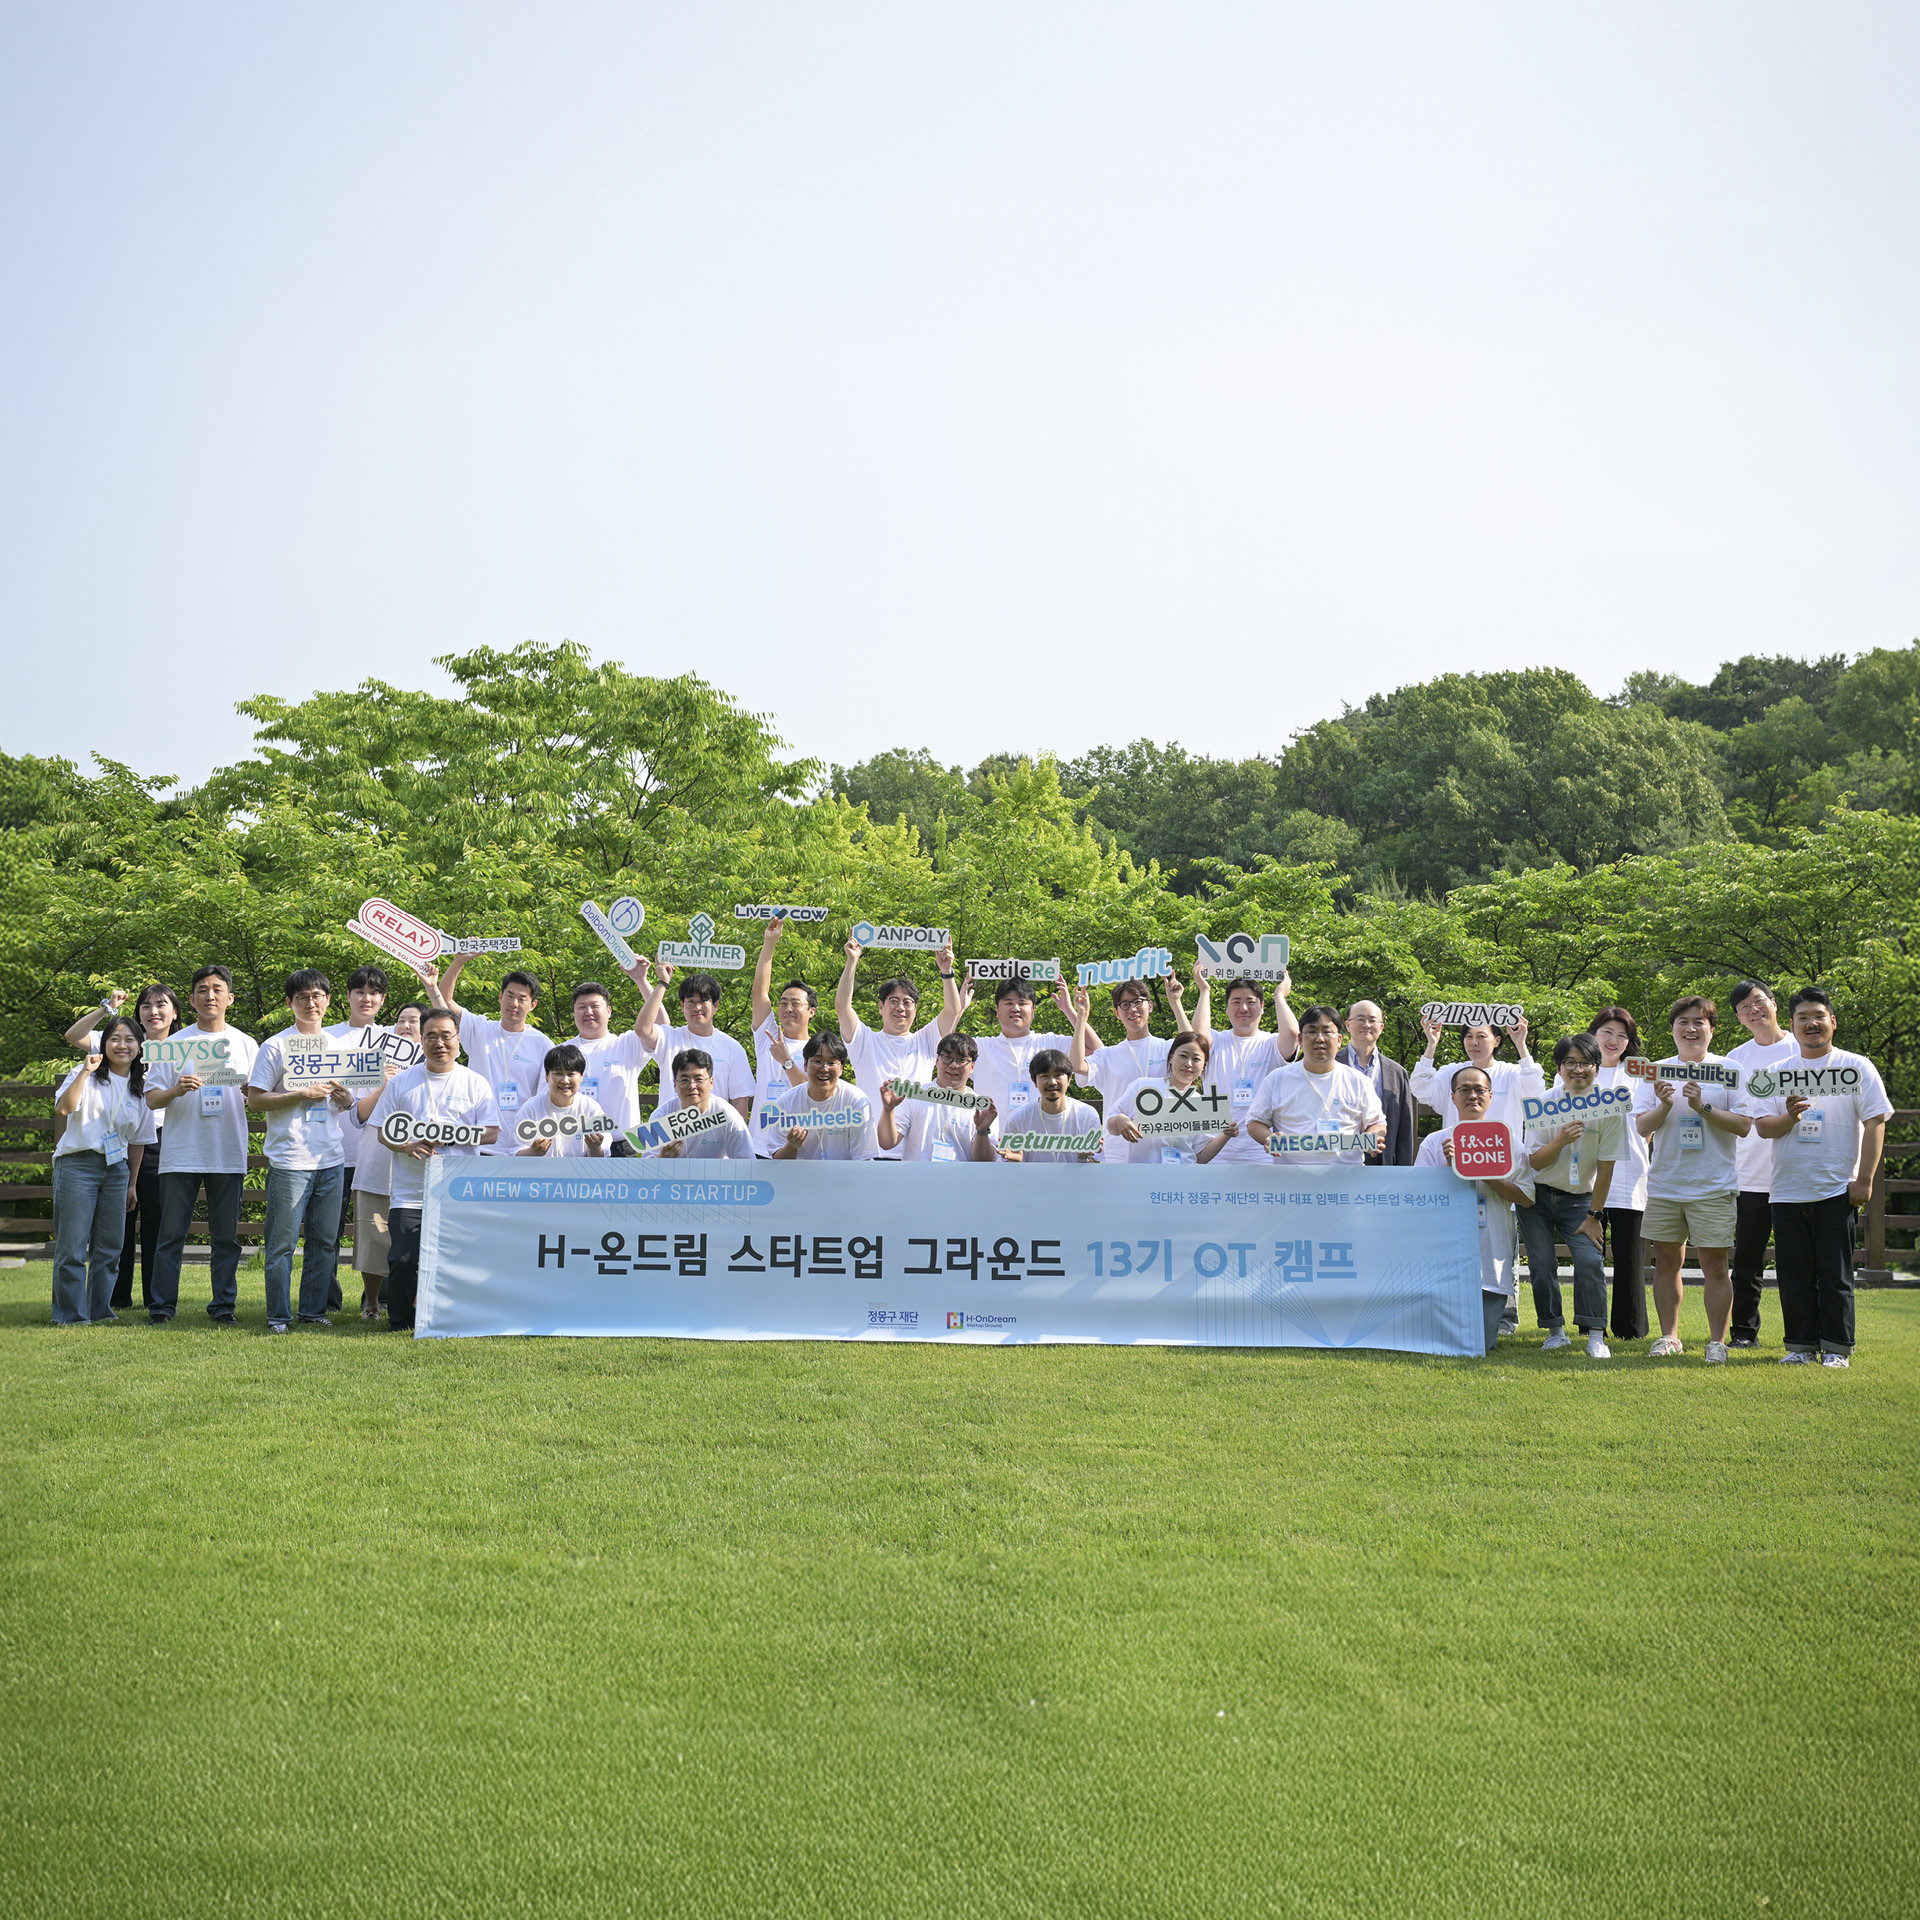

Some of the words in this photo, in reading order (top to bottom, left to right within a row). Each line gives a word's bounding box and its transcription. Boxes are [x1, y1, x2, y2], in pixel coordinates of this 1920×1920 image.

[735, 907, 770, 918] LIVE
[790, 909, 827, 921] COW
[372, 910, 431, 947] RELAY
[583, 904, 632, 968] DolbomDream
[877, 927, 947, 943] ANPOLY
[349, 923, 372, 938] BRAND
[372, 936, 397, 953] RESALE
[397, 952, 430, 973] SOLUTION
[459, 939, 518, 951] 한국주택정보
[661, 943, 741, 960] PLANTNER
[968, 961, 1055, 979] TextileRe
[1078, 949, 1172, 985] nurfit
[1215, 968, 1235, 978] 위한
[1242, 969, 1285, 979] 문화예술
[1422, 1004, 1521, 1027] PAIRINGS
[288, 1038, 323, 1052] 현대차
[143, 1040, 230, 1071] mysc
[288, 1053, 341, 1075] 정몽구
[346, 1052, 382, 1072] 재단
[216, 1078, 246, 1086] company
[1627, 1060, 1657, 1081] Big
[1660, 1064, 1737, 1087] mobility
[1779, 1068, 1859, 1087] PHYTO
[288, 1081, 309, 1089] Chung
[1780, 1087, 1859, 1095] RESEARCH
[1522, 1087, 1631, 1120] Dadadoc
[667, 1108, 699, 1127] ECO
[672, 1111, 727, 1139] MARINE
[760, 1104, 863, 1129] Pinwheels
[1529, 1104, 1631, 1129] HEALTHCARE
[413, 1122, 483, 1143] COBOT
[1137, 1119, 1230, 1134] (주)우리아이들플러스
[1000, 1130, 1102, 1150] returnall
[1270, 1134, 1376, 1152] MEGAPLAN
[1461, 1151, 1506, 1164] DONE
[462, 1182, 474, 1197] A
[483, 1182, 521, 1198] NEW
[529, 1182, 629, 1199] STANDARD
[637, 1184, 661, 1200] of
[671, 1184, 758, 1201] STARTUP
[1150, 1191, 1184, 1205] 현대차
[1187, 1191, 1222, 1205] 정몽구
[1225, 1192, 1259, 1205] 재단의
[1262, 1192, 1286, 1206] 국내
[1289, 1193, 1313, 1206] 대표
[1315, 1193, 1351, 1206] 임팩트
[1354, 1193, 1400, 1206] 스타트업
[1403, 1193, 1450, 1207] 육성사업
[538, 1231, 707, 1276] H-온드림
[728, 1234, 883, 1279] 스타트업
[904, 1237, 1065, 1280] 그라운드
[1087, 1238, 1172, 1282] 13기
[1193, 1242, 1256, 1278] OT
[1273, 1240, 1357, 1282] 캠프
[868, 1310, 897, 1323] 정몽구
[899, 1311, 919, 1323] 재단
[966, 1315, 1017, 1323] H-OnDream
